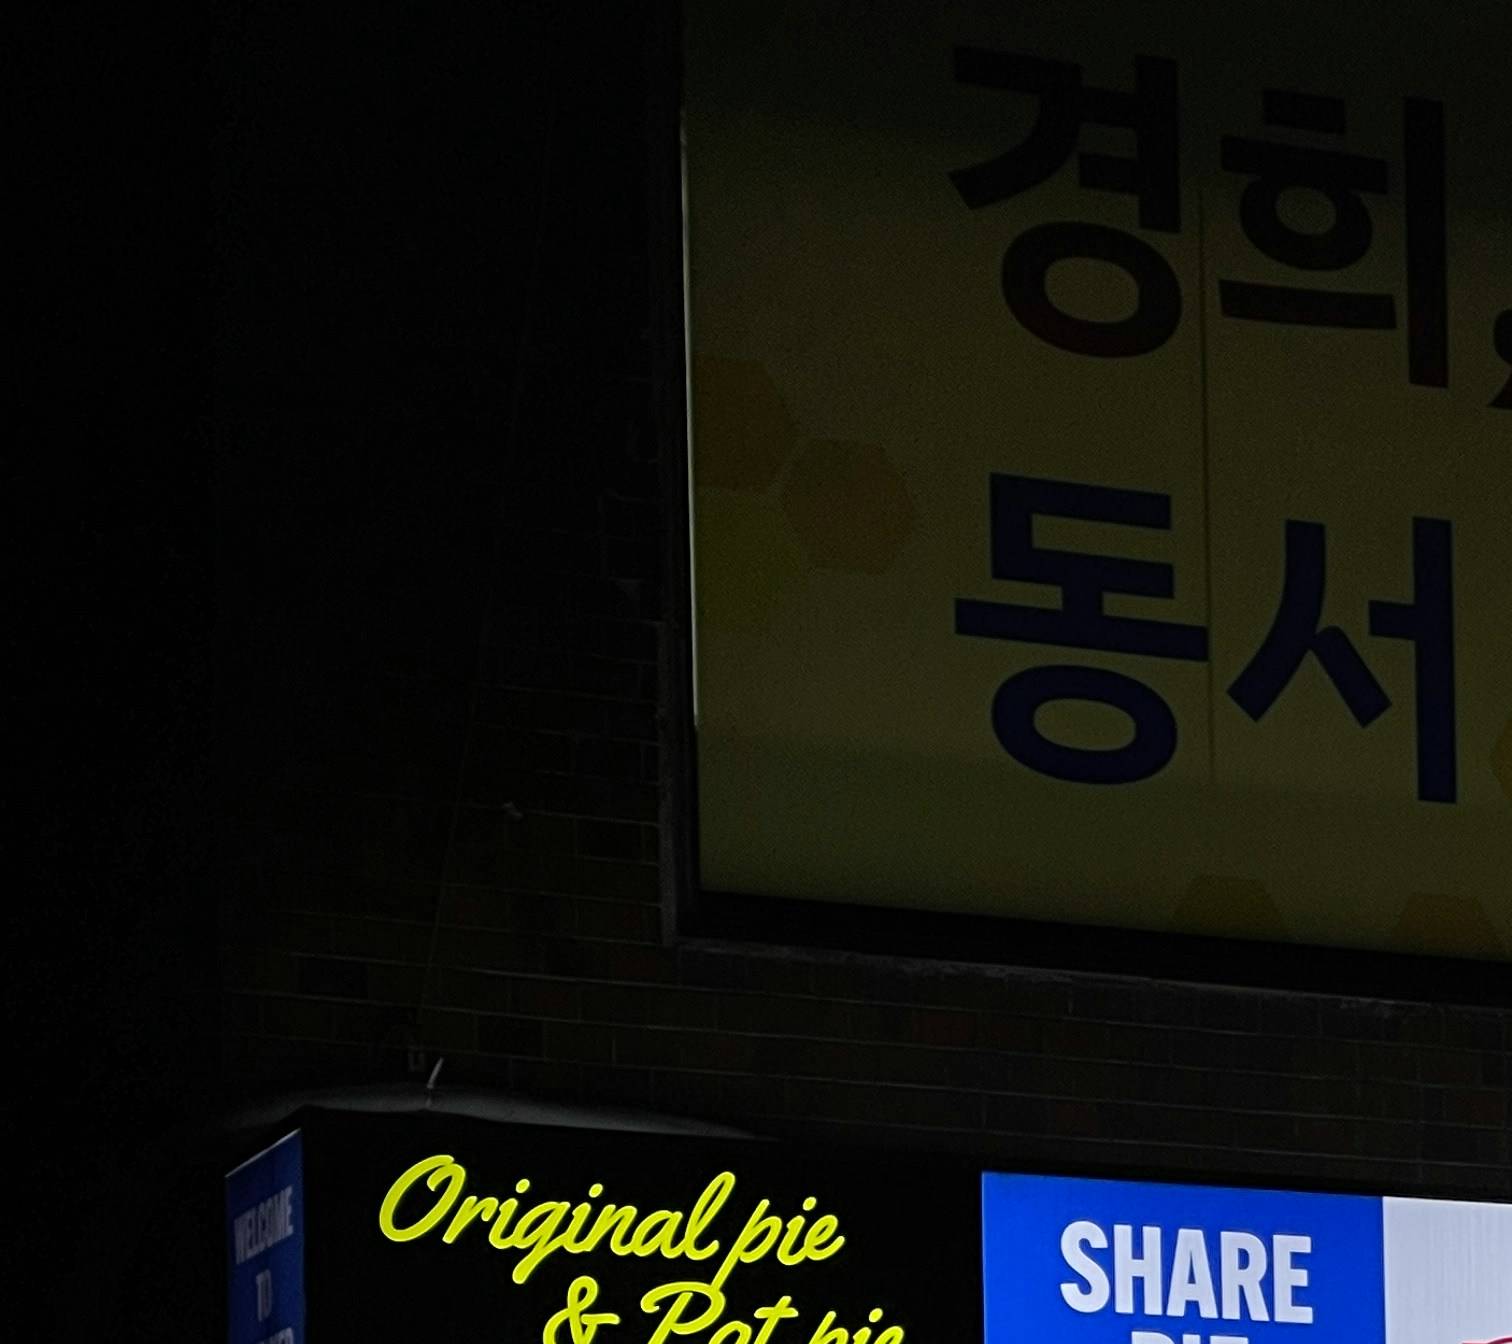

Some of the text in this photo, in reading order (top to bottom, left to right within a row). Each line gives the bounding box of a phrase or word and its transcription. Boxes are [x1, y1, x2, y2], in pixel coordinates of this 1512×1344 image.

[954, 473, 1457, 804] 동서
[378, 1154, 845, 1292] Original pie
[1059, 1220, 1314, 1324] SHARE
